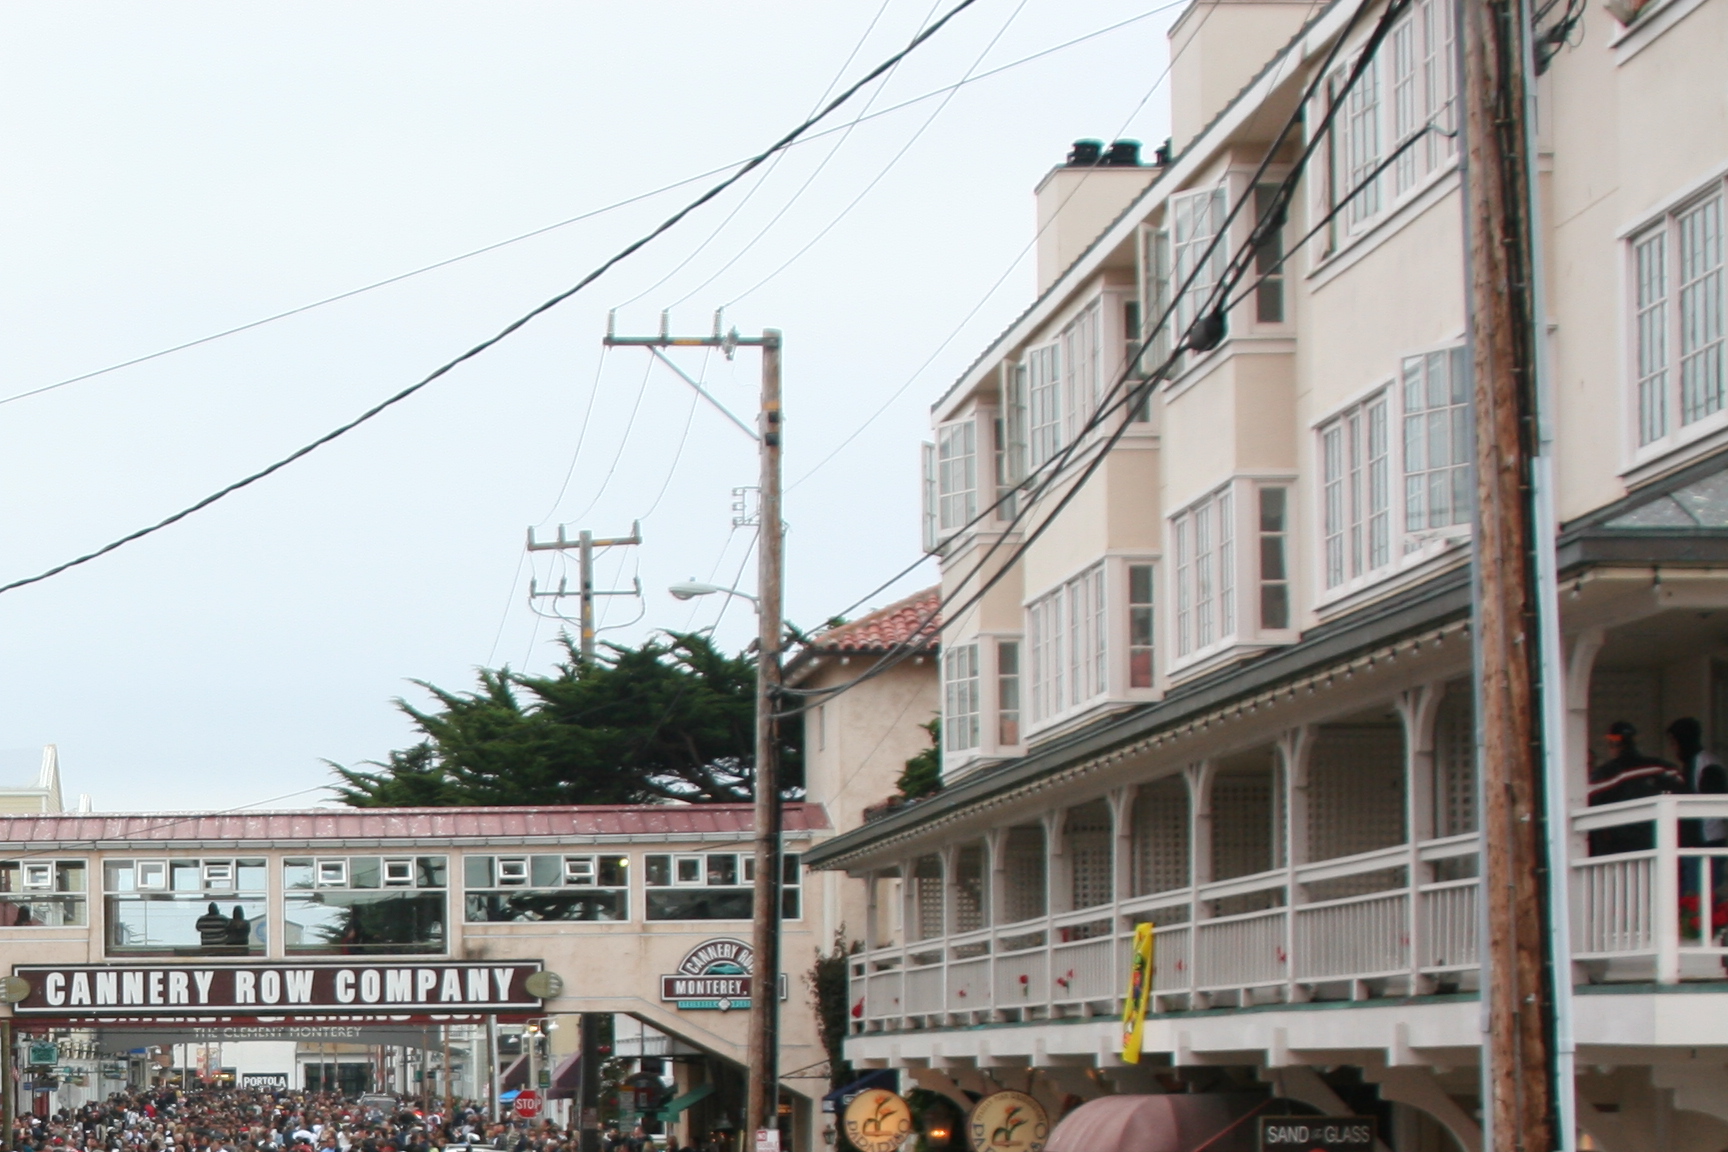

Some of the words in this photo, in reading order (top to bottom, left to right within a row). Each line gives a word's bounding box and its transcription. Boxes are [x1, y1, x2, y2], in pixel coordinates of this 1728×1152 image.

[685, 943, 740, 974] CANNERY
[46, 970, 214, 1006] CANNERY
[235, 969, 315, 1005] ROW
[336, 968, 515, 1004] COMPANY
[223, 1027, 282, 1039] CLEMENT
[290, 1026, 363, 1038] MONTEREY
[243, 1076, 287, 1089] PORTOLA
[1267, 1126, 1310, 1143] SAND
[1324, 1125, 1370, 1143] GLASS
